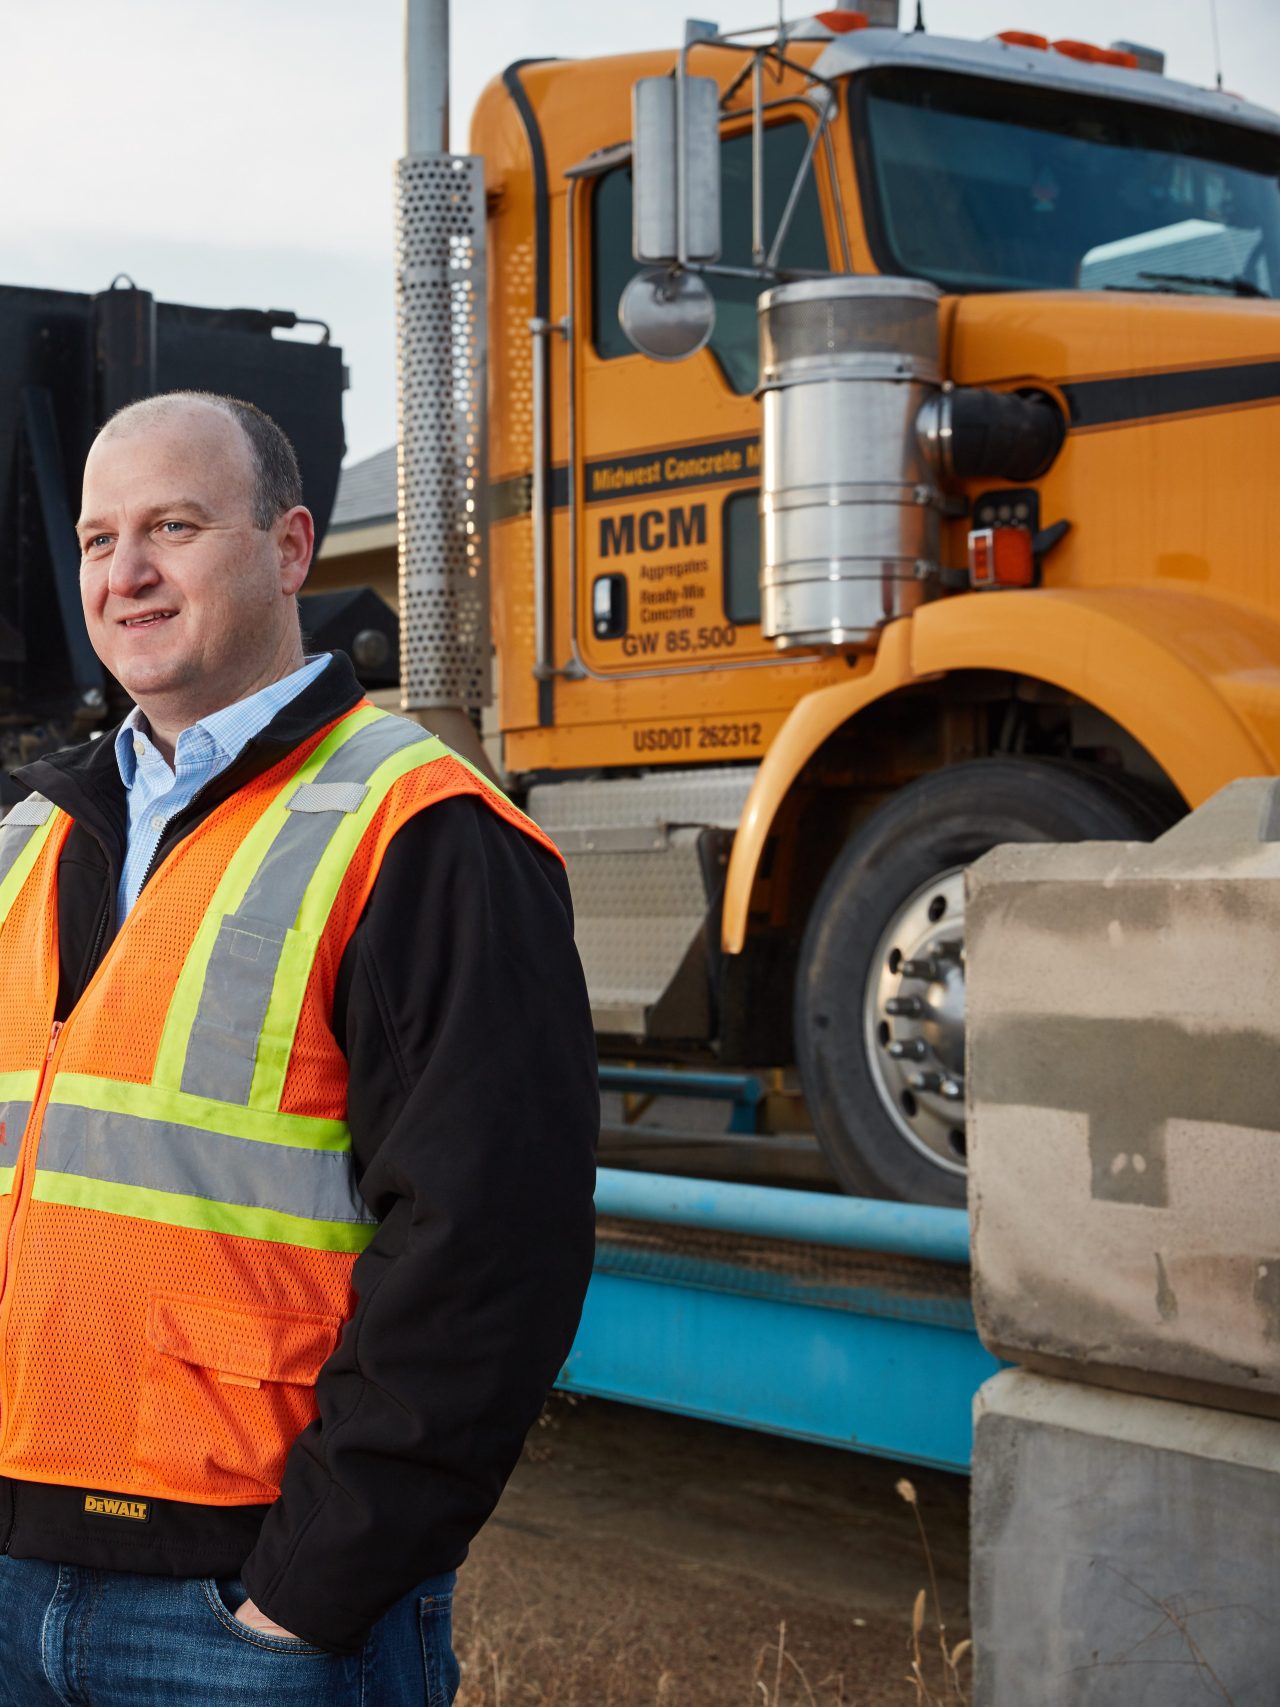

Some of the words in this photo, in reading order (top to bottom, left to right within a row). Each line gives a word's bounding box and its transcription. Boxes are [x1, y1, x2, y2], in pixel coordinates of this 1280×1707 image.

[592, 461, 661, 492] Midwest
[664, 451, 741, 481] Concrete
[599, 504, 707, 557] MCM
[640, 559, 709, 580] Aggregates
[640, 605, 695, 623] Concrete
[622, 631, 659, 656] GW
[665, 625, 737, 653] 85,500
[633, 727, 693, 752] USDOT
[698, 722, 762, 749] 262312
